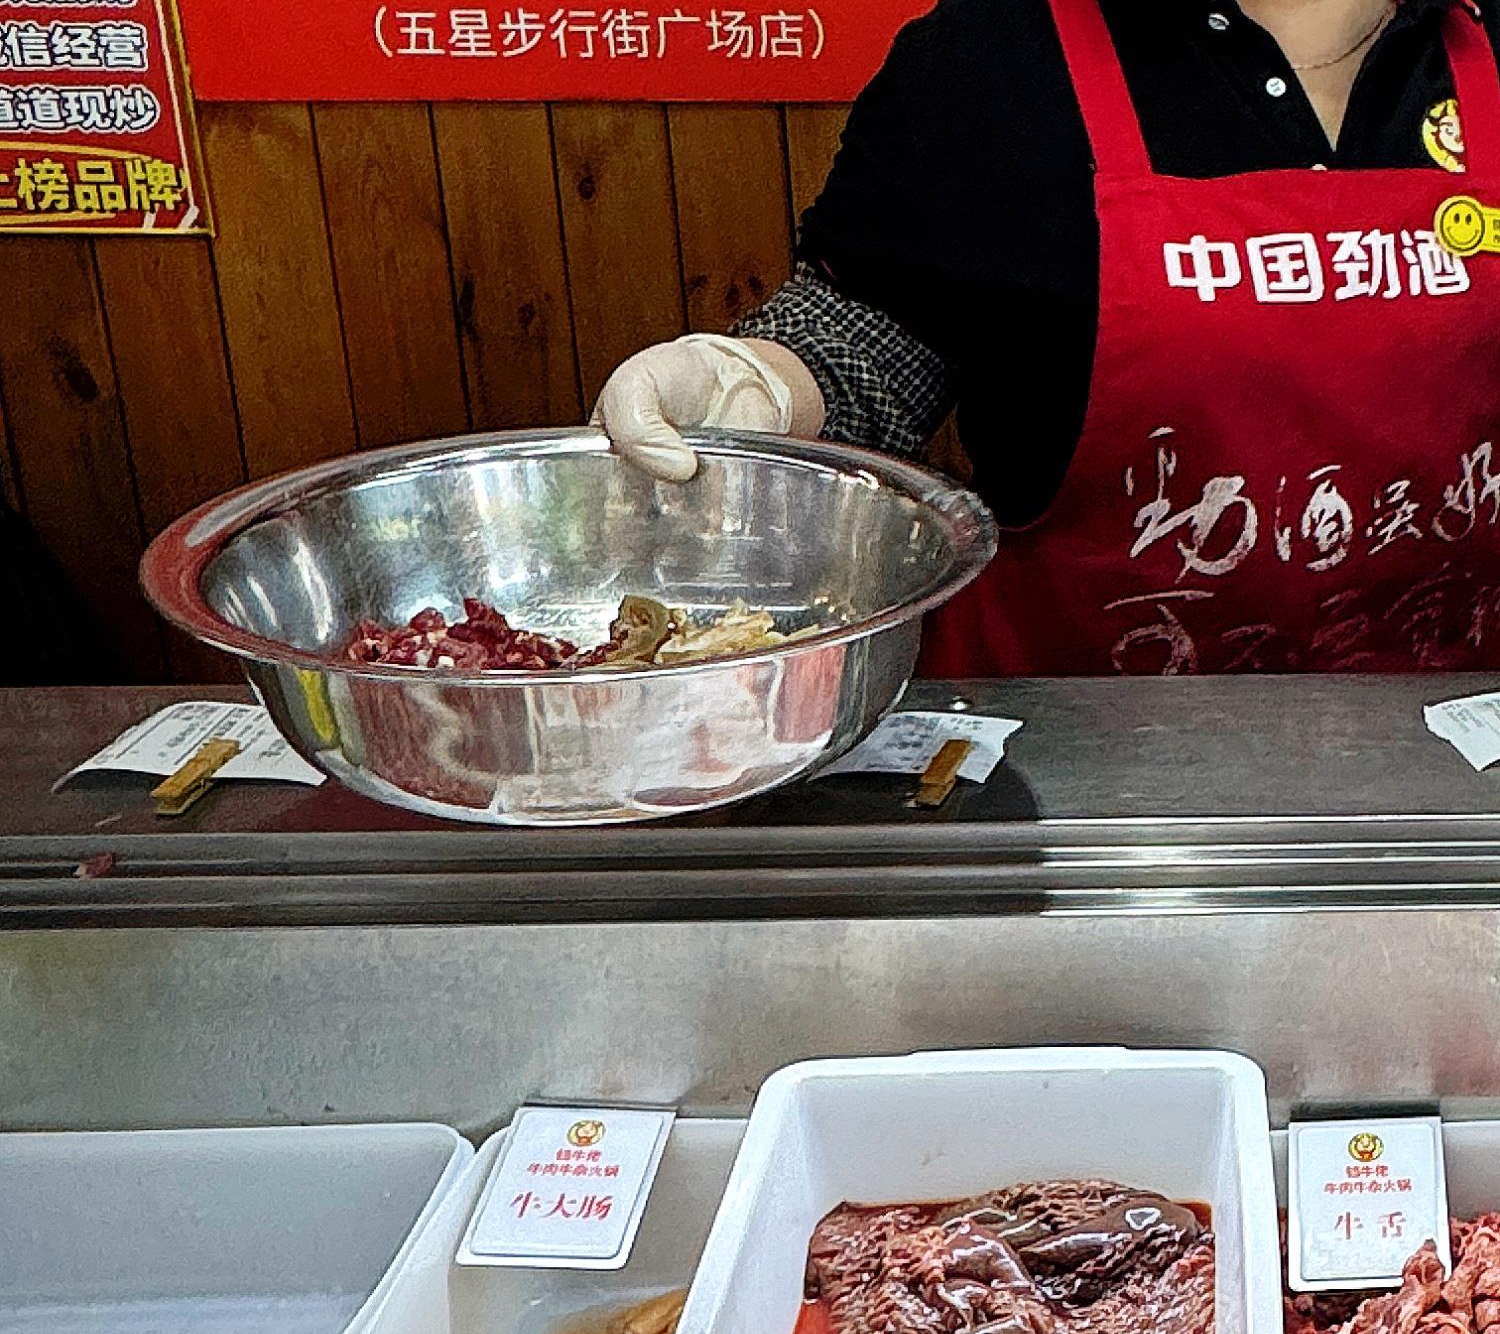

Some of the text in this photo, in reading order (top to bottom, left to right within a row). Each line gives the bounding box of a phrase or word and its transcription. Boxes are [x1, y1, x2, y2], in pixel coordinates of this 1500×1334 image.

[374, 5, 827, 61] （五星步行街广场店）
[1163, 229, 1471, 304] 中国劲酒
[510, 1191, 614, 1221] 牛大肠
